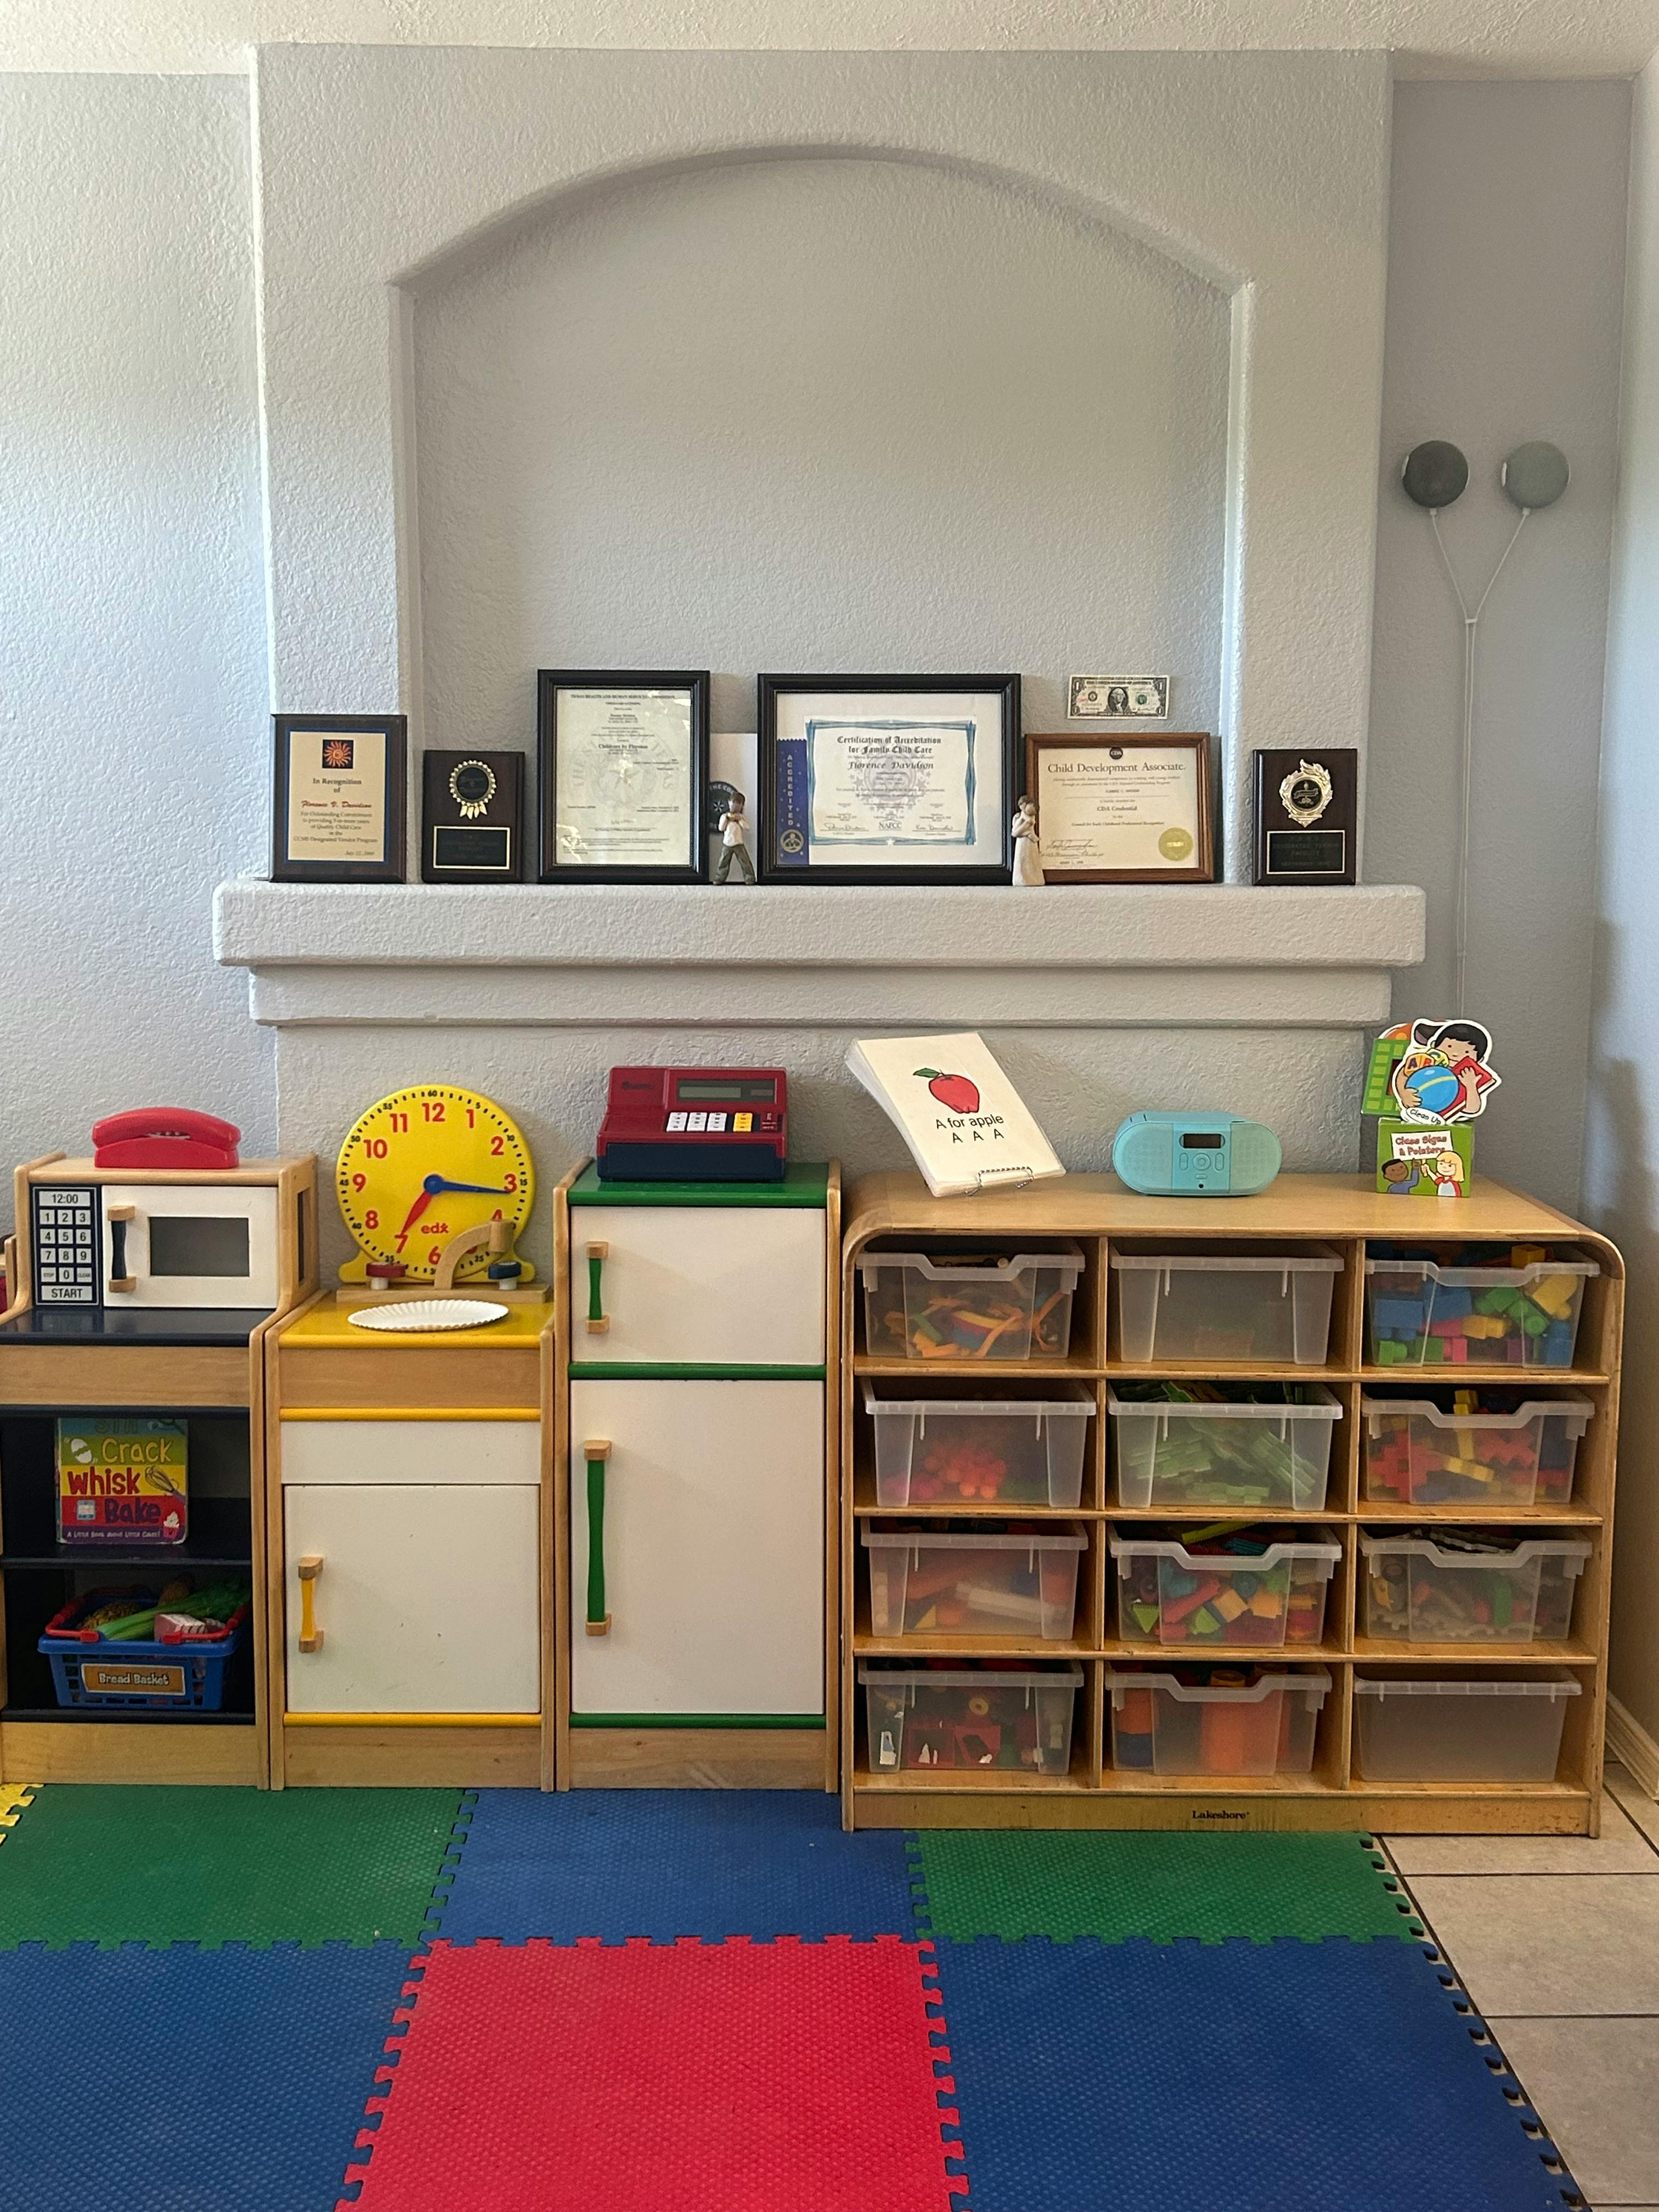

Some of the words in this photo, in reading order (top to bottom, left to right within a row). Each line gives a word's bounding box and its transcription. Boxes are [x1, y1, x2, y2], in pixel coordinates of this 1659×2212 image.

[837, 736, 882, 744] Certification
[894, 736, 941, 744] Accreditation
[861, 746, 889, 755] Family
[1048, 763, 1073, 773] Child
[1077, 763, 1137, 775] Development
[1407, 1058, 1418, 1069] A
[421, 1102, 445, 1122] 12
[466, 1109, 475, 1128] 1
[1410, 1109, 1429, 1120] Clean
[1431, 1116, 1441, 1125] Up
[390, 1113, 408, 1133] 11
[935, 1119, 946, 1130] A
[947, 1117, 965, 1128] for
[969, 1114, 1005, 1127] apple
[952, 1132, 963, 1143] A
[973, 1131, 984, 1142] A
[994, 1128, 1005, 1139] A
[1395, 1136, 1420, 1146] Class
[1422, 1134, 1447, 1146] Signs
[363, 1139, 387, 1159] 10
[491, 1136, 504, 1155] 2
[1407, 1146, 1445, 1155] Pointers
[352, 1173, 366, 1193] 9
[504, 1173, 517, 1194] 3
[52, 1194, 78, 1204] 12:00
[45, 1212, 49, 1222] 1
[63, 1212, 69, 1222] 2
[80, 1212, 86, 1222] 3
[365, 1210, 379, 1229] 8
[45, 1232, 51, 1241] 4
[63, 1232, 69, 1242] 5
[80, 1232, 86, 1242] 6
[394, 1235, 408, 1254] 7
[46, 1251, 52, 1260] 7
[63, 1251, 69, 1260] 8
[81, 1251, 87, 1261] 9
[428, 1246, 441, 1265] 6
[64, 1269, 70, 1279] 0
[51, 1288, 83, 1299] START
[102, 1437, 173, 1463] Crack
[104, 1497, 161, 1523] Bake
[99, 1673, 130, 1684] Bread
[134, 1674, 170, 1685] Basket
[1192, 1810, 1246, 1819] Lakeshore
